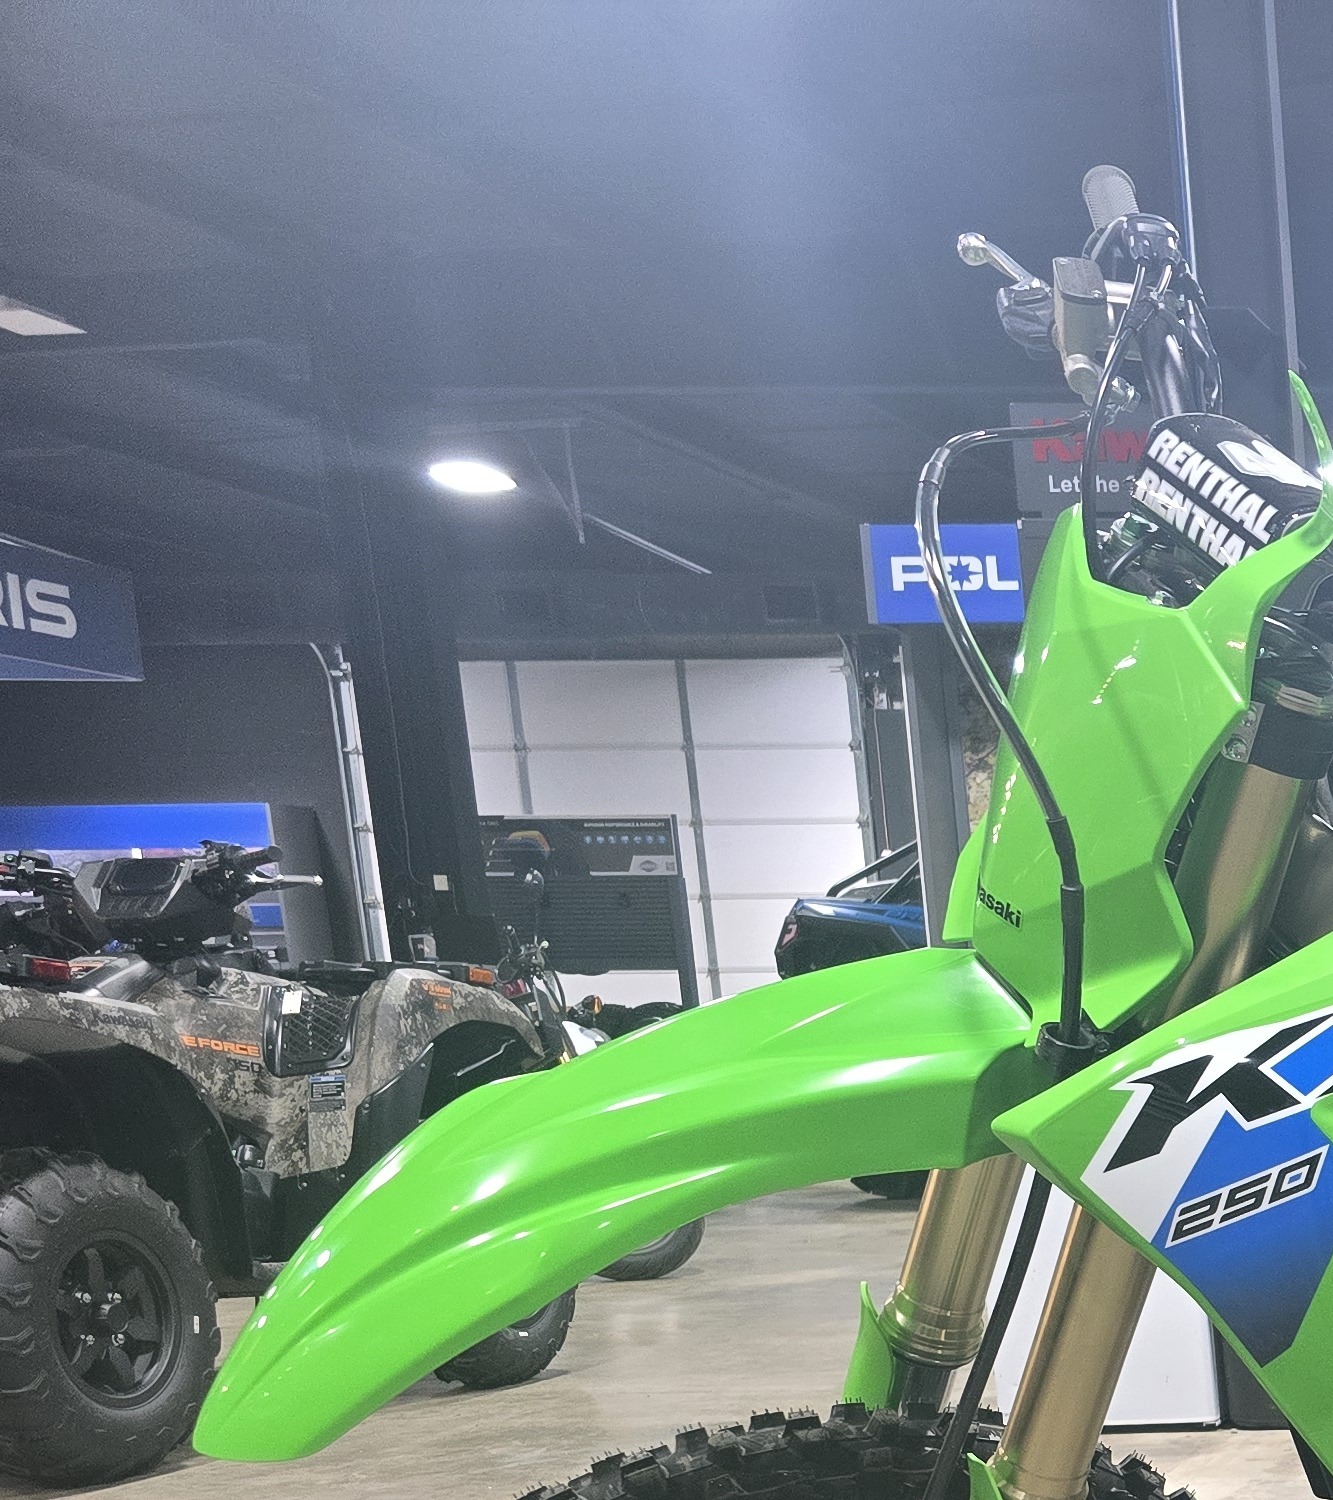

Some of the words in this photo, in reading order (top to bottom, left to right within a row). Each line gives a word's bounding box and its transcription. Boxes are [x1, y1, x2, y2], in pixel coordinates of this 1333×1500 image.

[1048, 475, 1081, 493] Let
[1095, 475, 1120, 493] he
[1133, 466, 1258, 567] RENTHA
[1147, 428, 1280, 545] RENTHAL
[979, 886, 1022, 929] asaki
[198, 1037, 261, 1057] FORCE
[1171, 1150, 1323, 1244] 250
